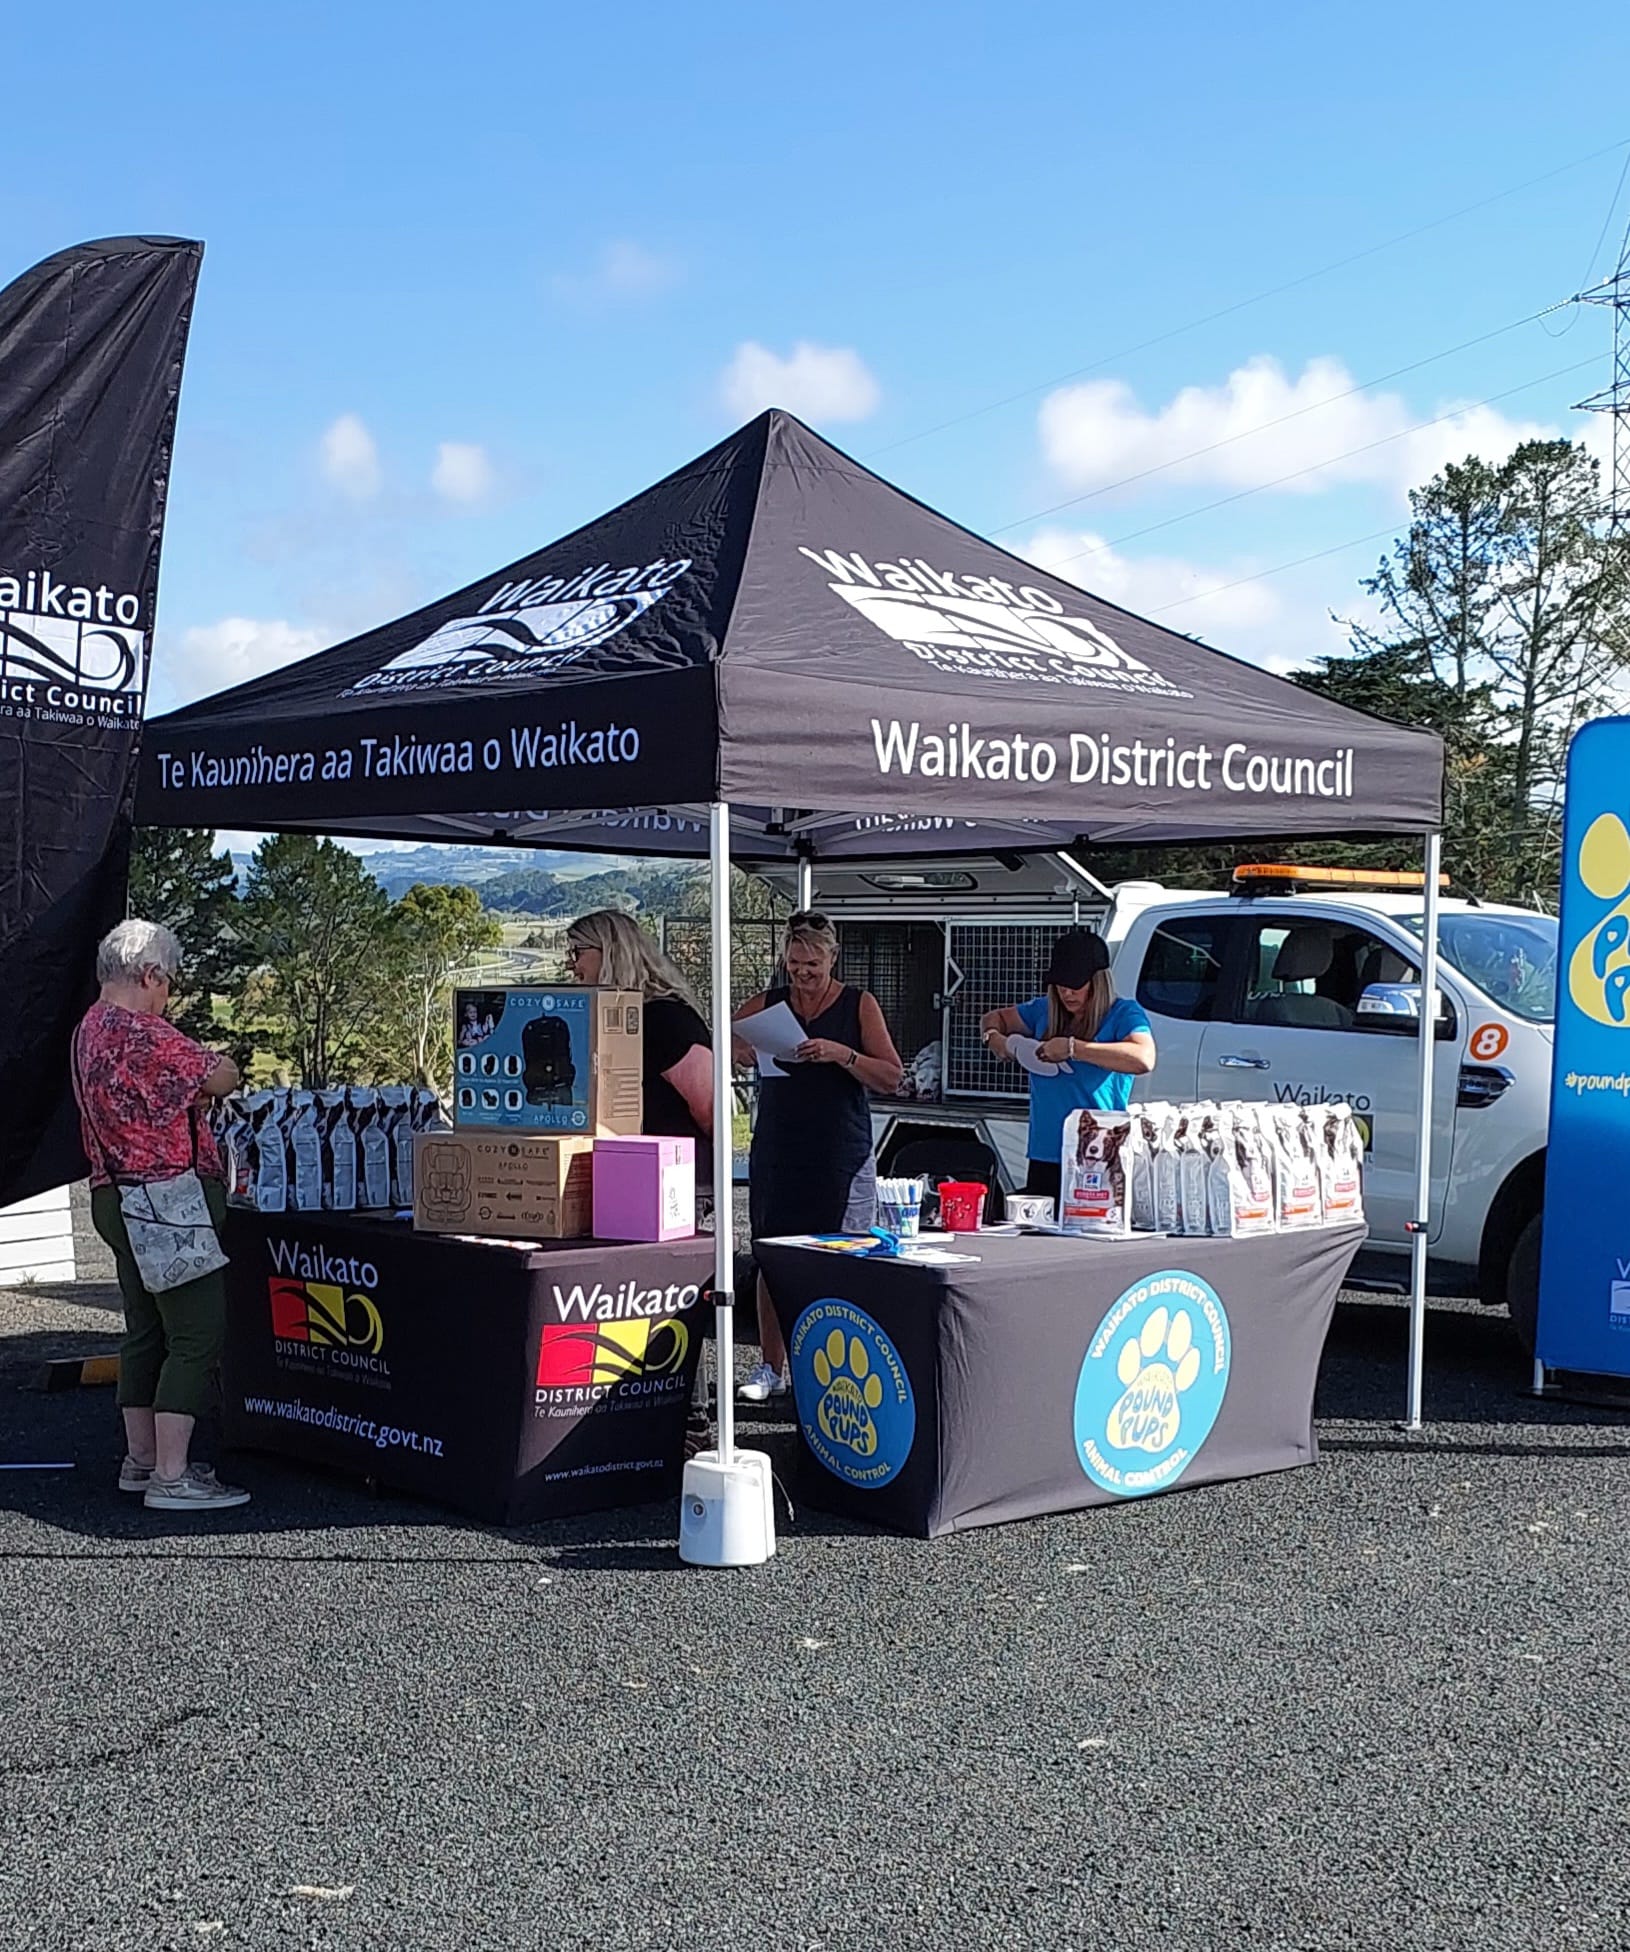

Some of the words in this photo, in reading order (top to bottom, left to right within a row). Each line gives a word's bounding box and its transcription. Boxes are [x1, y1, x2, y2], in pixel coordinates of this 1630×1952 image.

[477, 559, 693, 614] Waikato
[798, 546, 1065, 615] Waikato
[352, 663, 467, 690] District
[468, 646, 594, 676] Council
[902, 640, 1048, 672] District
[1048, 658, 1177, 688] Council
[16, 705, 31, 718] aa
[35, 706, 84, 725] Takiwaa
[86, 715, 95, 726] o
[47, 685, 142, 716] Council
[157, 753, 184, 789] Te
[191, 745, 314, 787] Kaunihera
[320, 748, 352, 780] aa
[360, 734, 473, 778] Takiwaa
[483, 738, 501, 771] o
[510, 721, 640, 769] Waikato
[870, 718, 1057, 783] Waikato
[1070, 733, 1212, 790] District
[1222, 743, 1354, 797] Council
[510, 998, 541, 1007] COZY
[556, 999, 585, 1009] SAFE
[1476, 1027, 1501, 1056] 8
[533, 1114, 568, 1126] APOLLO
[477, 1144, 506, 1154] COZY
[266, 1236, 379, 1289] Waikato
[552, 1280, 699, 1323] Waikato
[1091, 1287, 1148, 1359] WAIKATO
[1150, 1277, 1207, 1305] DISTRICT
[1202, 1300, 1226, 1375] COUNCIL
[275, 1339, 326, 1361] DISTRICT
[331, 1350, 391, 1376] COUNCIL
[793, 1307, 824, 1356] WAIKATO
[825, 1305, 875, 1336] DISTRICT
[874, 1334, 908, 1405] COUNCIL
[535, 1384, 612, 1404] DISTRICT
[619, 1374, 687, 1398] COUNCIL
[823, 1393, 869, 1428] POUND
[1118, 1385, 1174, 1424] POUND
[244, 1395, 444, 1458] www.waikatodistrict.govt.nz
[829, 1415, 870, 1454] PUPS
[1120, 1413, 1169, 1448] PUPS
[804, 1423, 842, 1471] ANIMAL
[844, 1462, 892, 1481] CONTROL
[1083, 1439, 1123, 1485] ANIMAL
[1124, 1447, 1189, 1487] CONTROL
